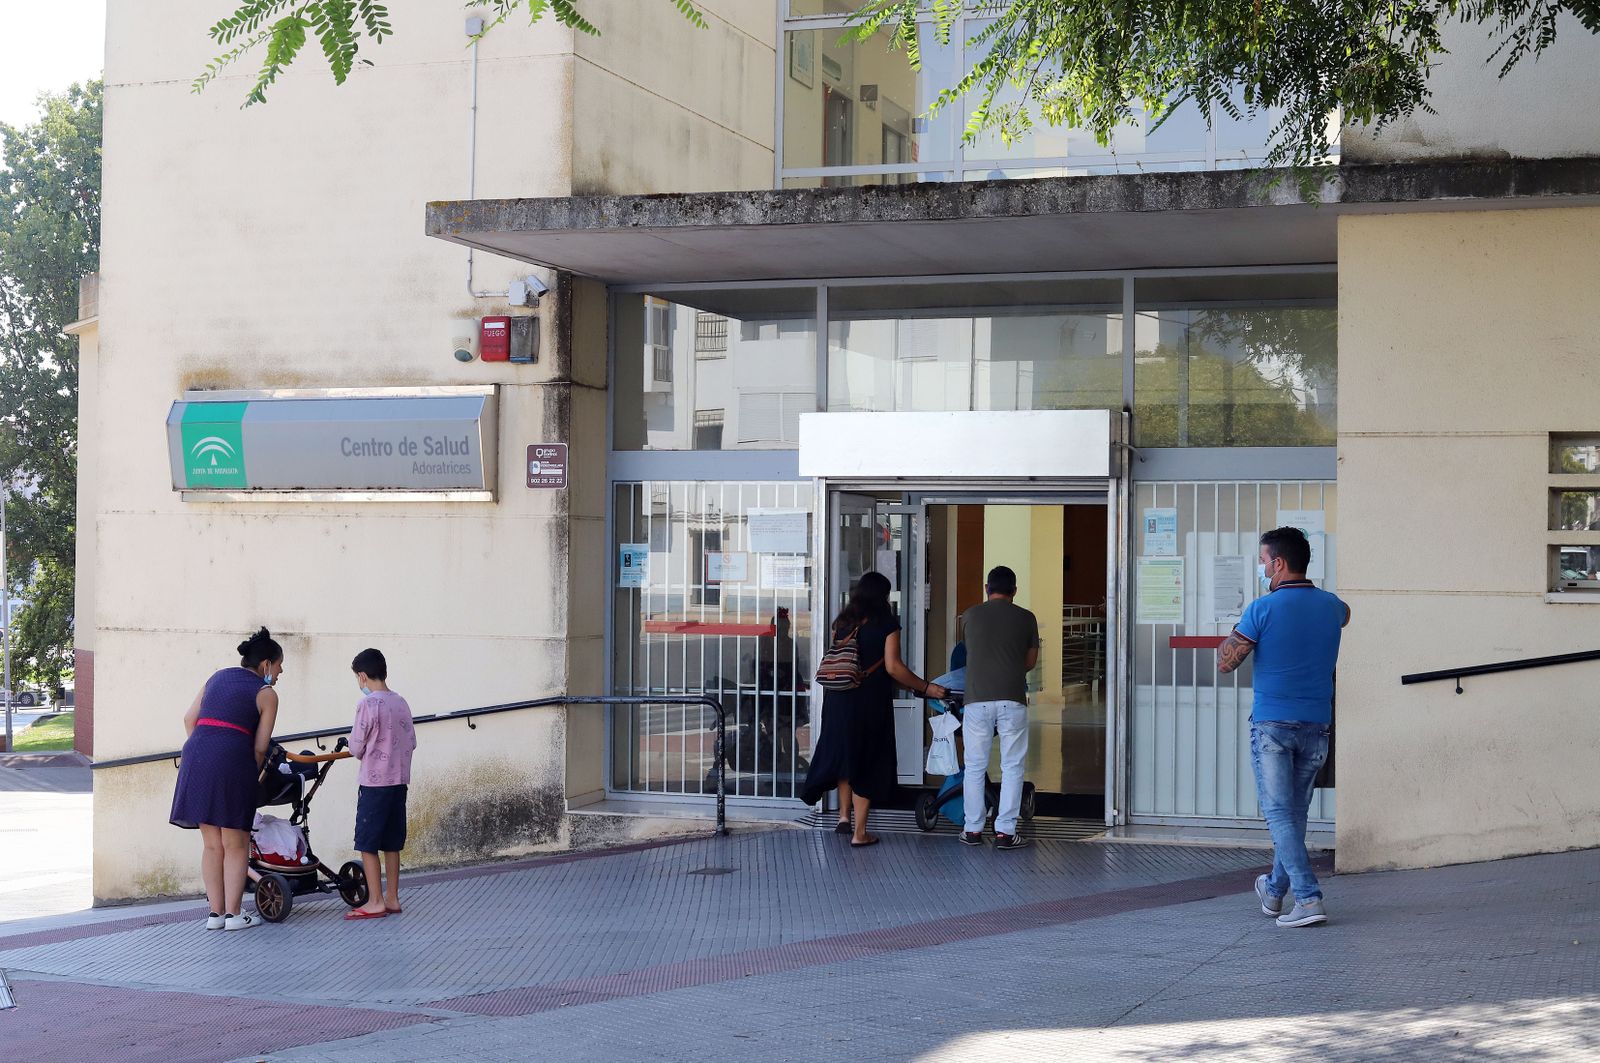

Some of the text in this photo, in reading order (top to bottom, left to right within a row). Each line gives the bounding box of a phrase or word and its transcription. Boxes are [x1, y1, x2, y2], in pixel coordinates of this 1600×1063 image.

[341, 435, 470, 457] Centro de Salud
[412, 461, 472, 475] Adoratrices
